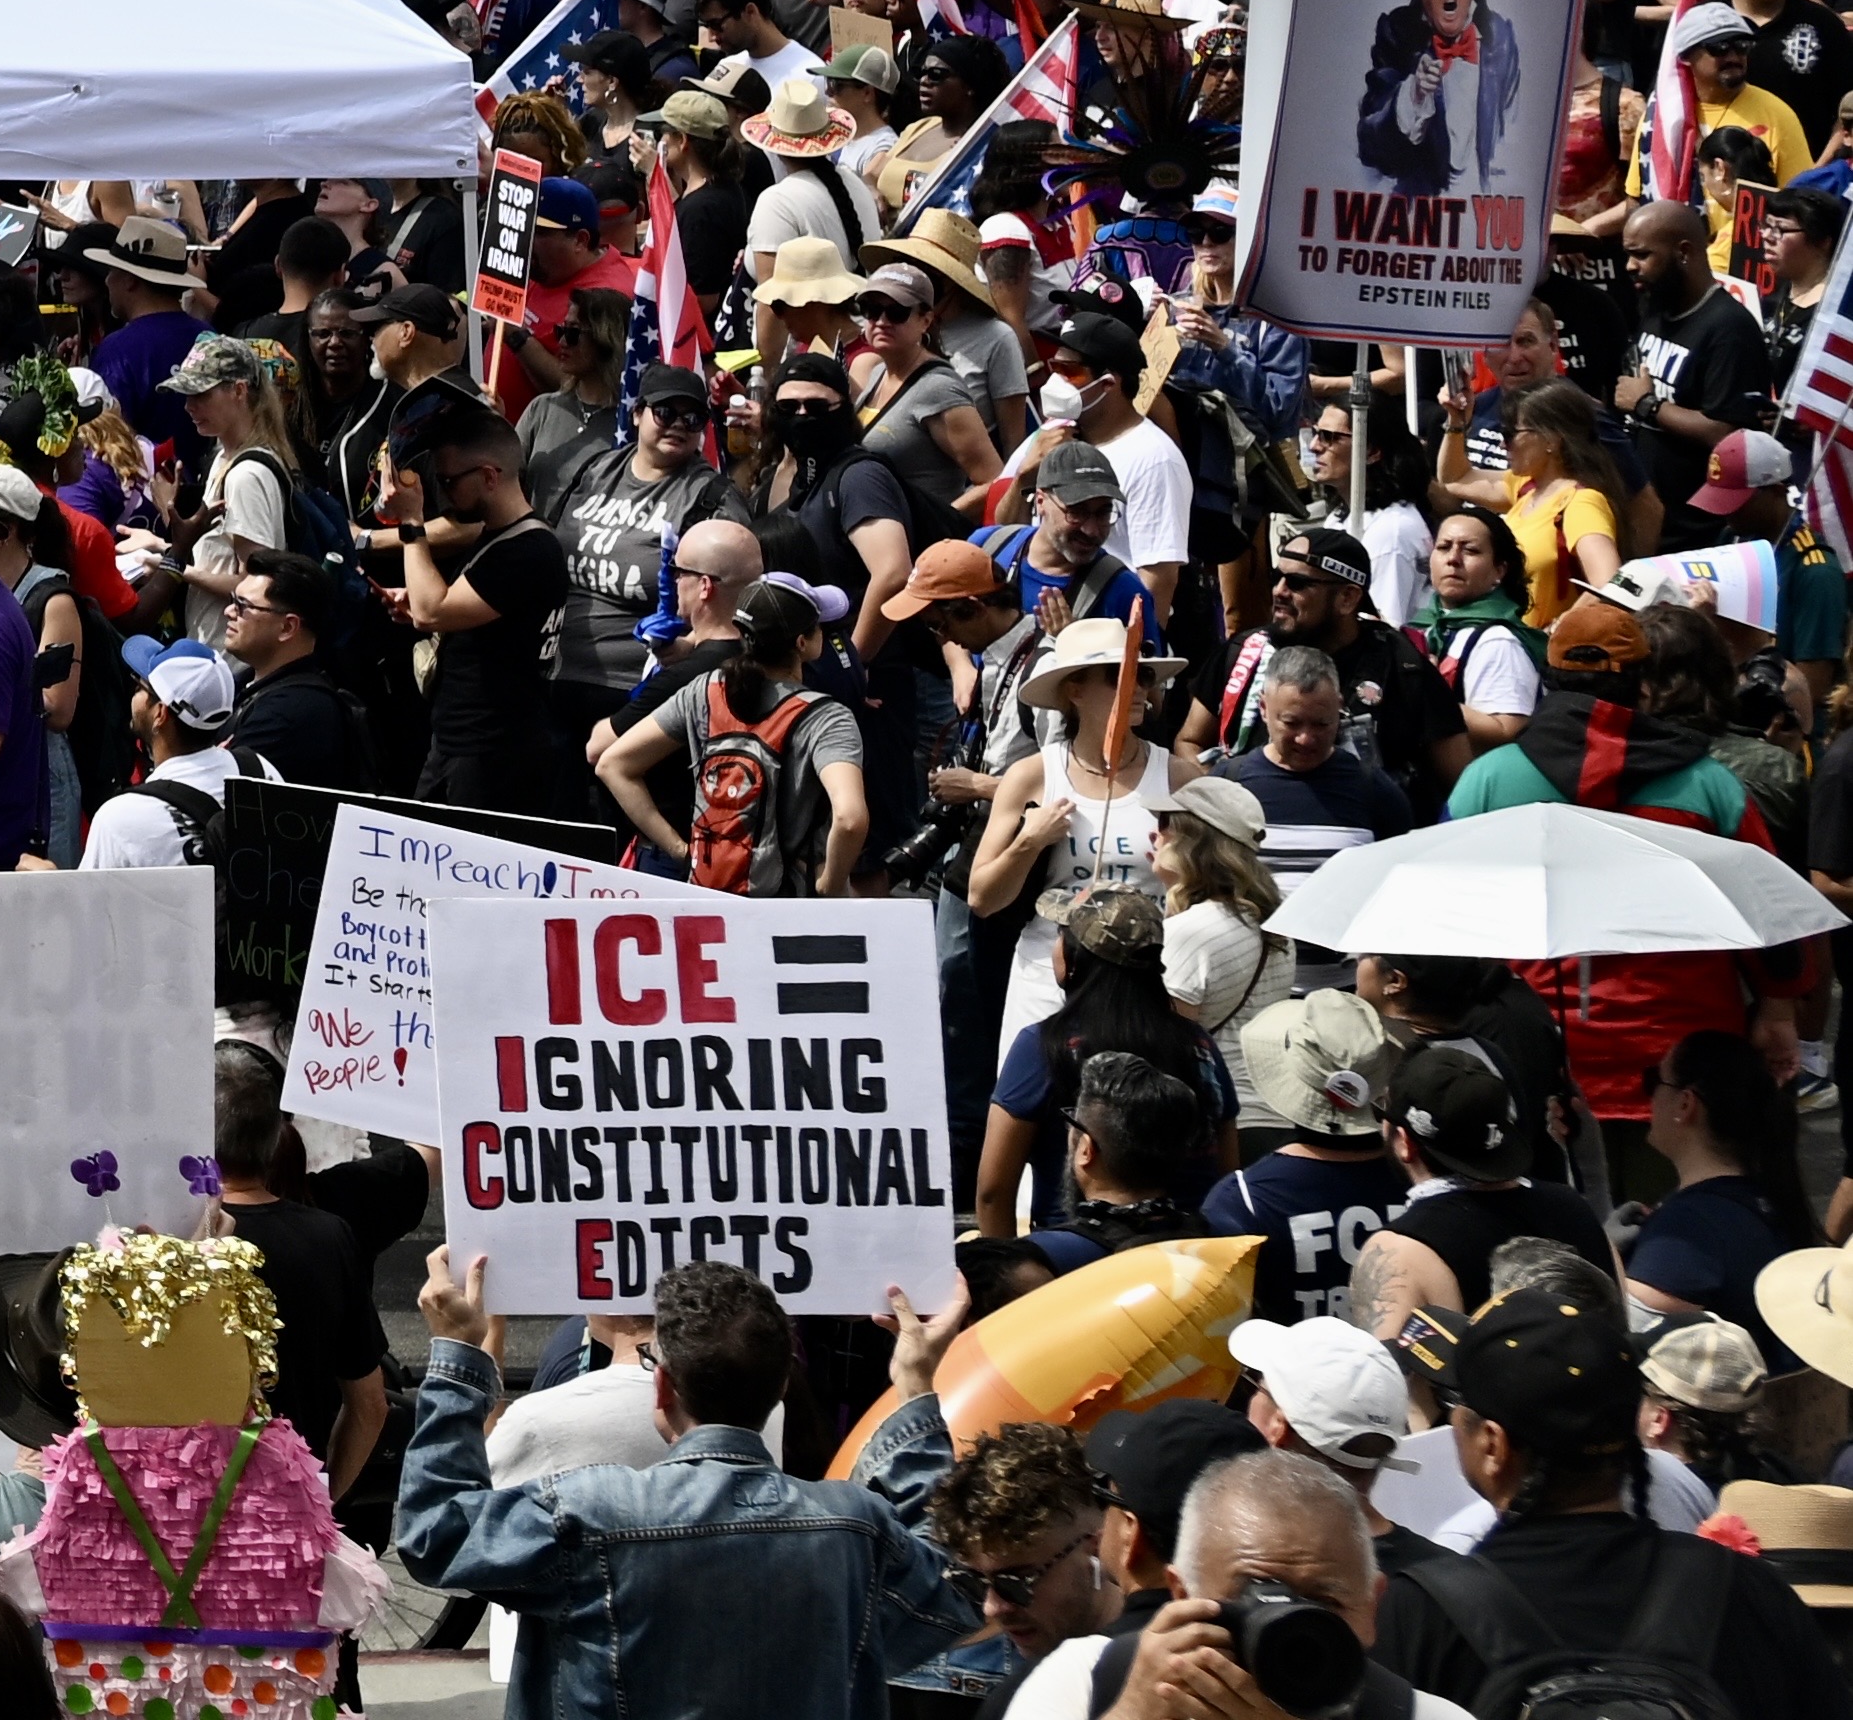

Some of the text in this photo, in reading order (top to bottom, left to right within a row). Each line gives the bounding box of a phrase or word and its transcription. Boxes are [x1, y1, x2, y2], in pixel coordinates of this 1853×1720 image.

[497, 179, 535, 206] STOP
[497, 206, 527, 231] WAR
[500, 229, 520, 252] ON
[1301, 188, 1525, 251] I WANT YOU
[487, 247, 524, 279] IRAN!
[1299, 245, 1523, 285] TO FORGET ABOUT THE
[1358, 283, 1491, 310] EPSTEIN FILES
[358, 822, 559, 900] Impeach!
[543, 914, 738, 1027] ICE
[309, 1007, 374, 1052] We
[302, 1044, 409, 1096] People!
[495, 1034, 888, 1113] IGNORING
[462, 1121, 945, 1210] CONSTITUTIONAL
[575, 1214, 813, 1301] EDICTS
